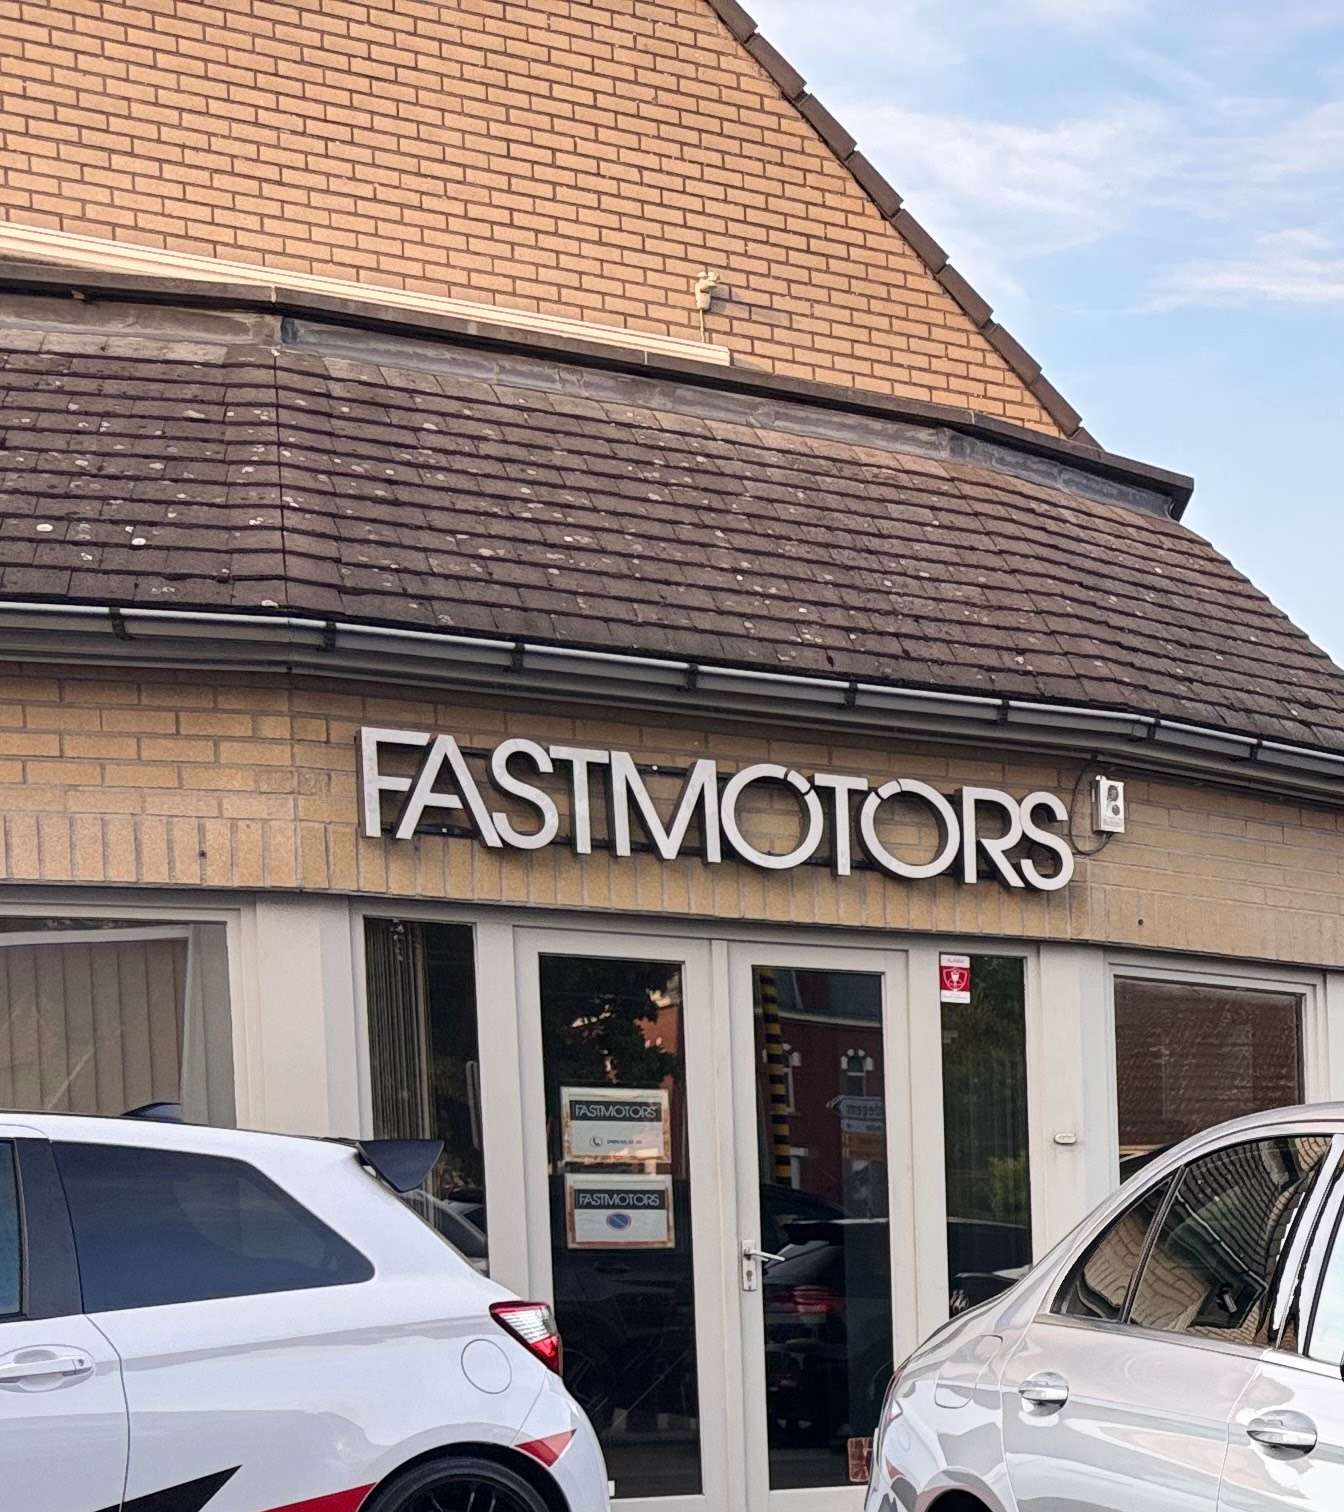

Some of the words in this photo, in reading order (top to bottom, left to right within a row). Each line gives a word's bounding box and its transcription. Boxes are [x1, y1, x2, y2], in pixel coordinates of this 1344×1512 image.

[359, 726, 1075, 892] FASTMOTORS
[576, 1104, 657, 1118] FASTMOTORS
[579, 1193, 660, 1206] FASTMOTORS
